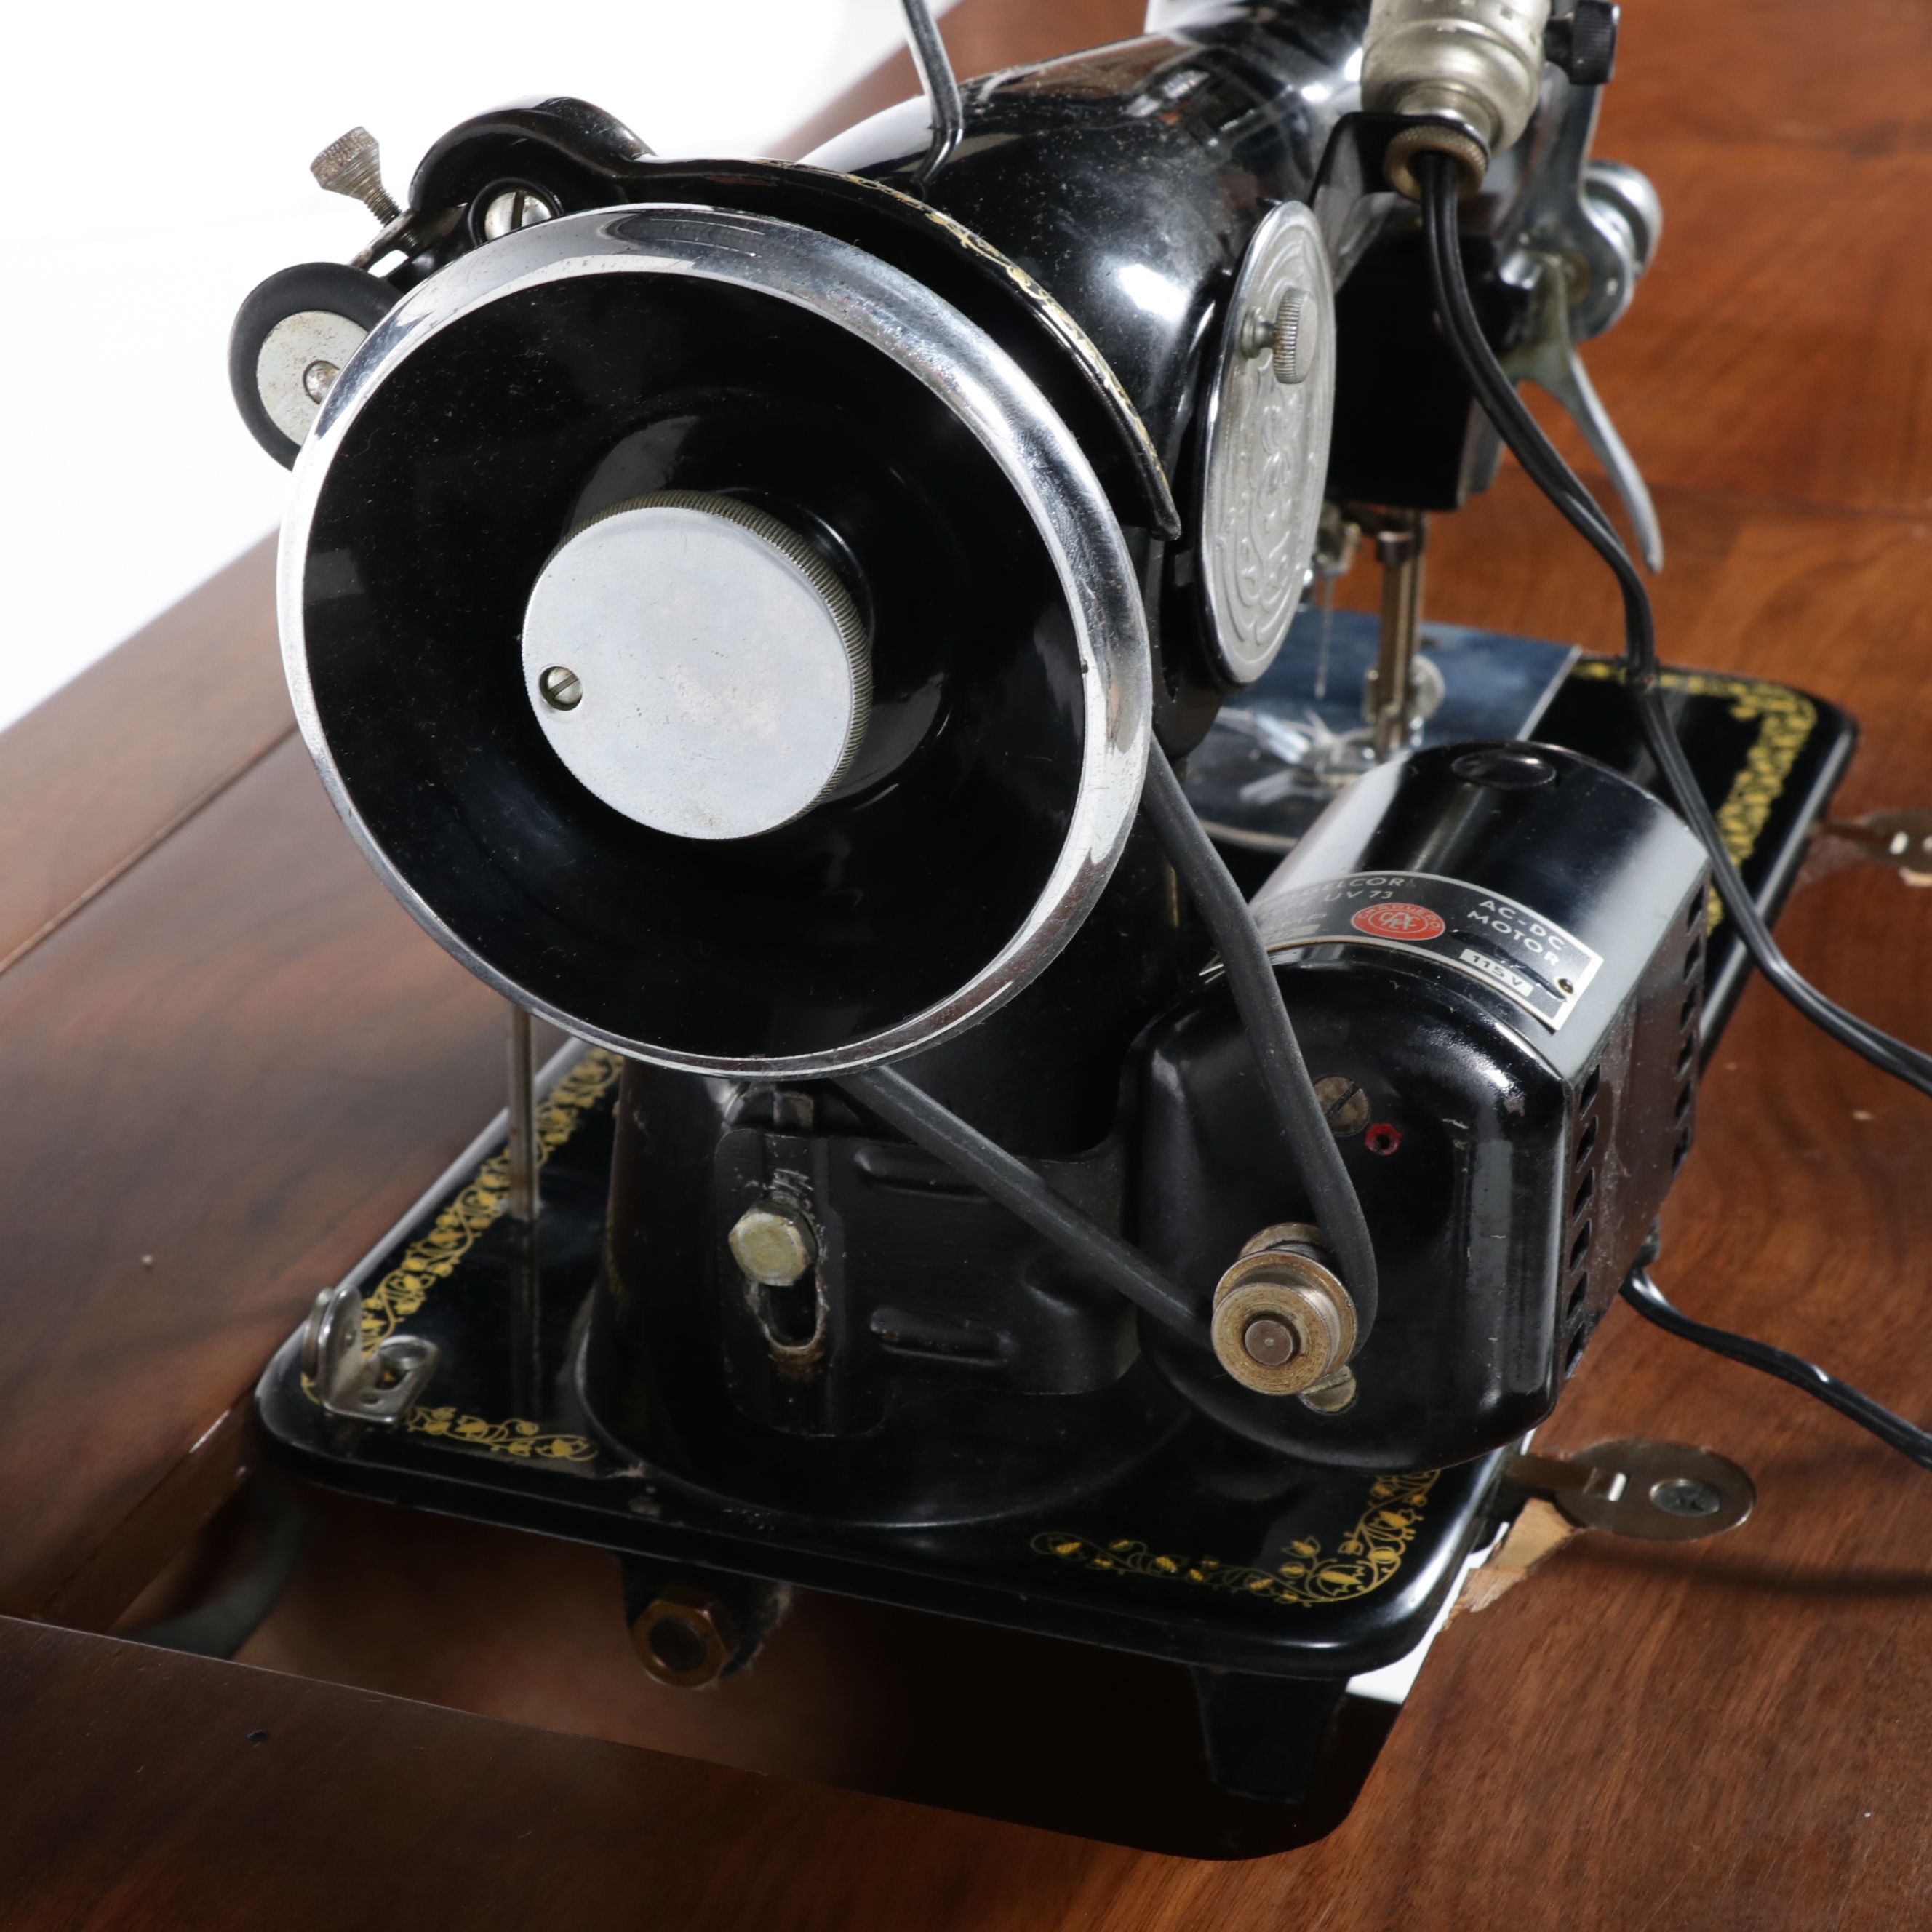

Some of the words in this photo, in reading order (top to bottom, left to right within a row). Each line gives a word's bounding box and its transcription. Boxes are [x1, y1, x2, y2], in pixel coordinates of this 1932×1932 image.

[1368, 890, 1394, 900] 73
[1466, 910, 1559, 967] MOTOR
[1472, 955, 1505, 977] 115
